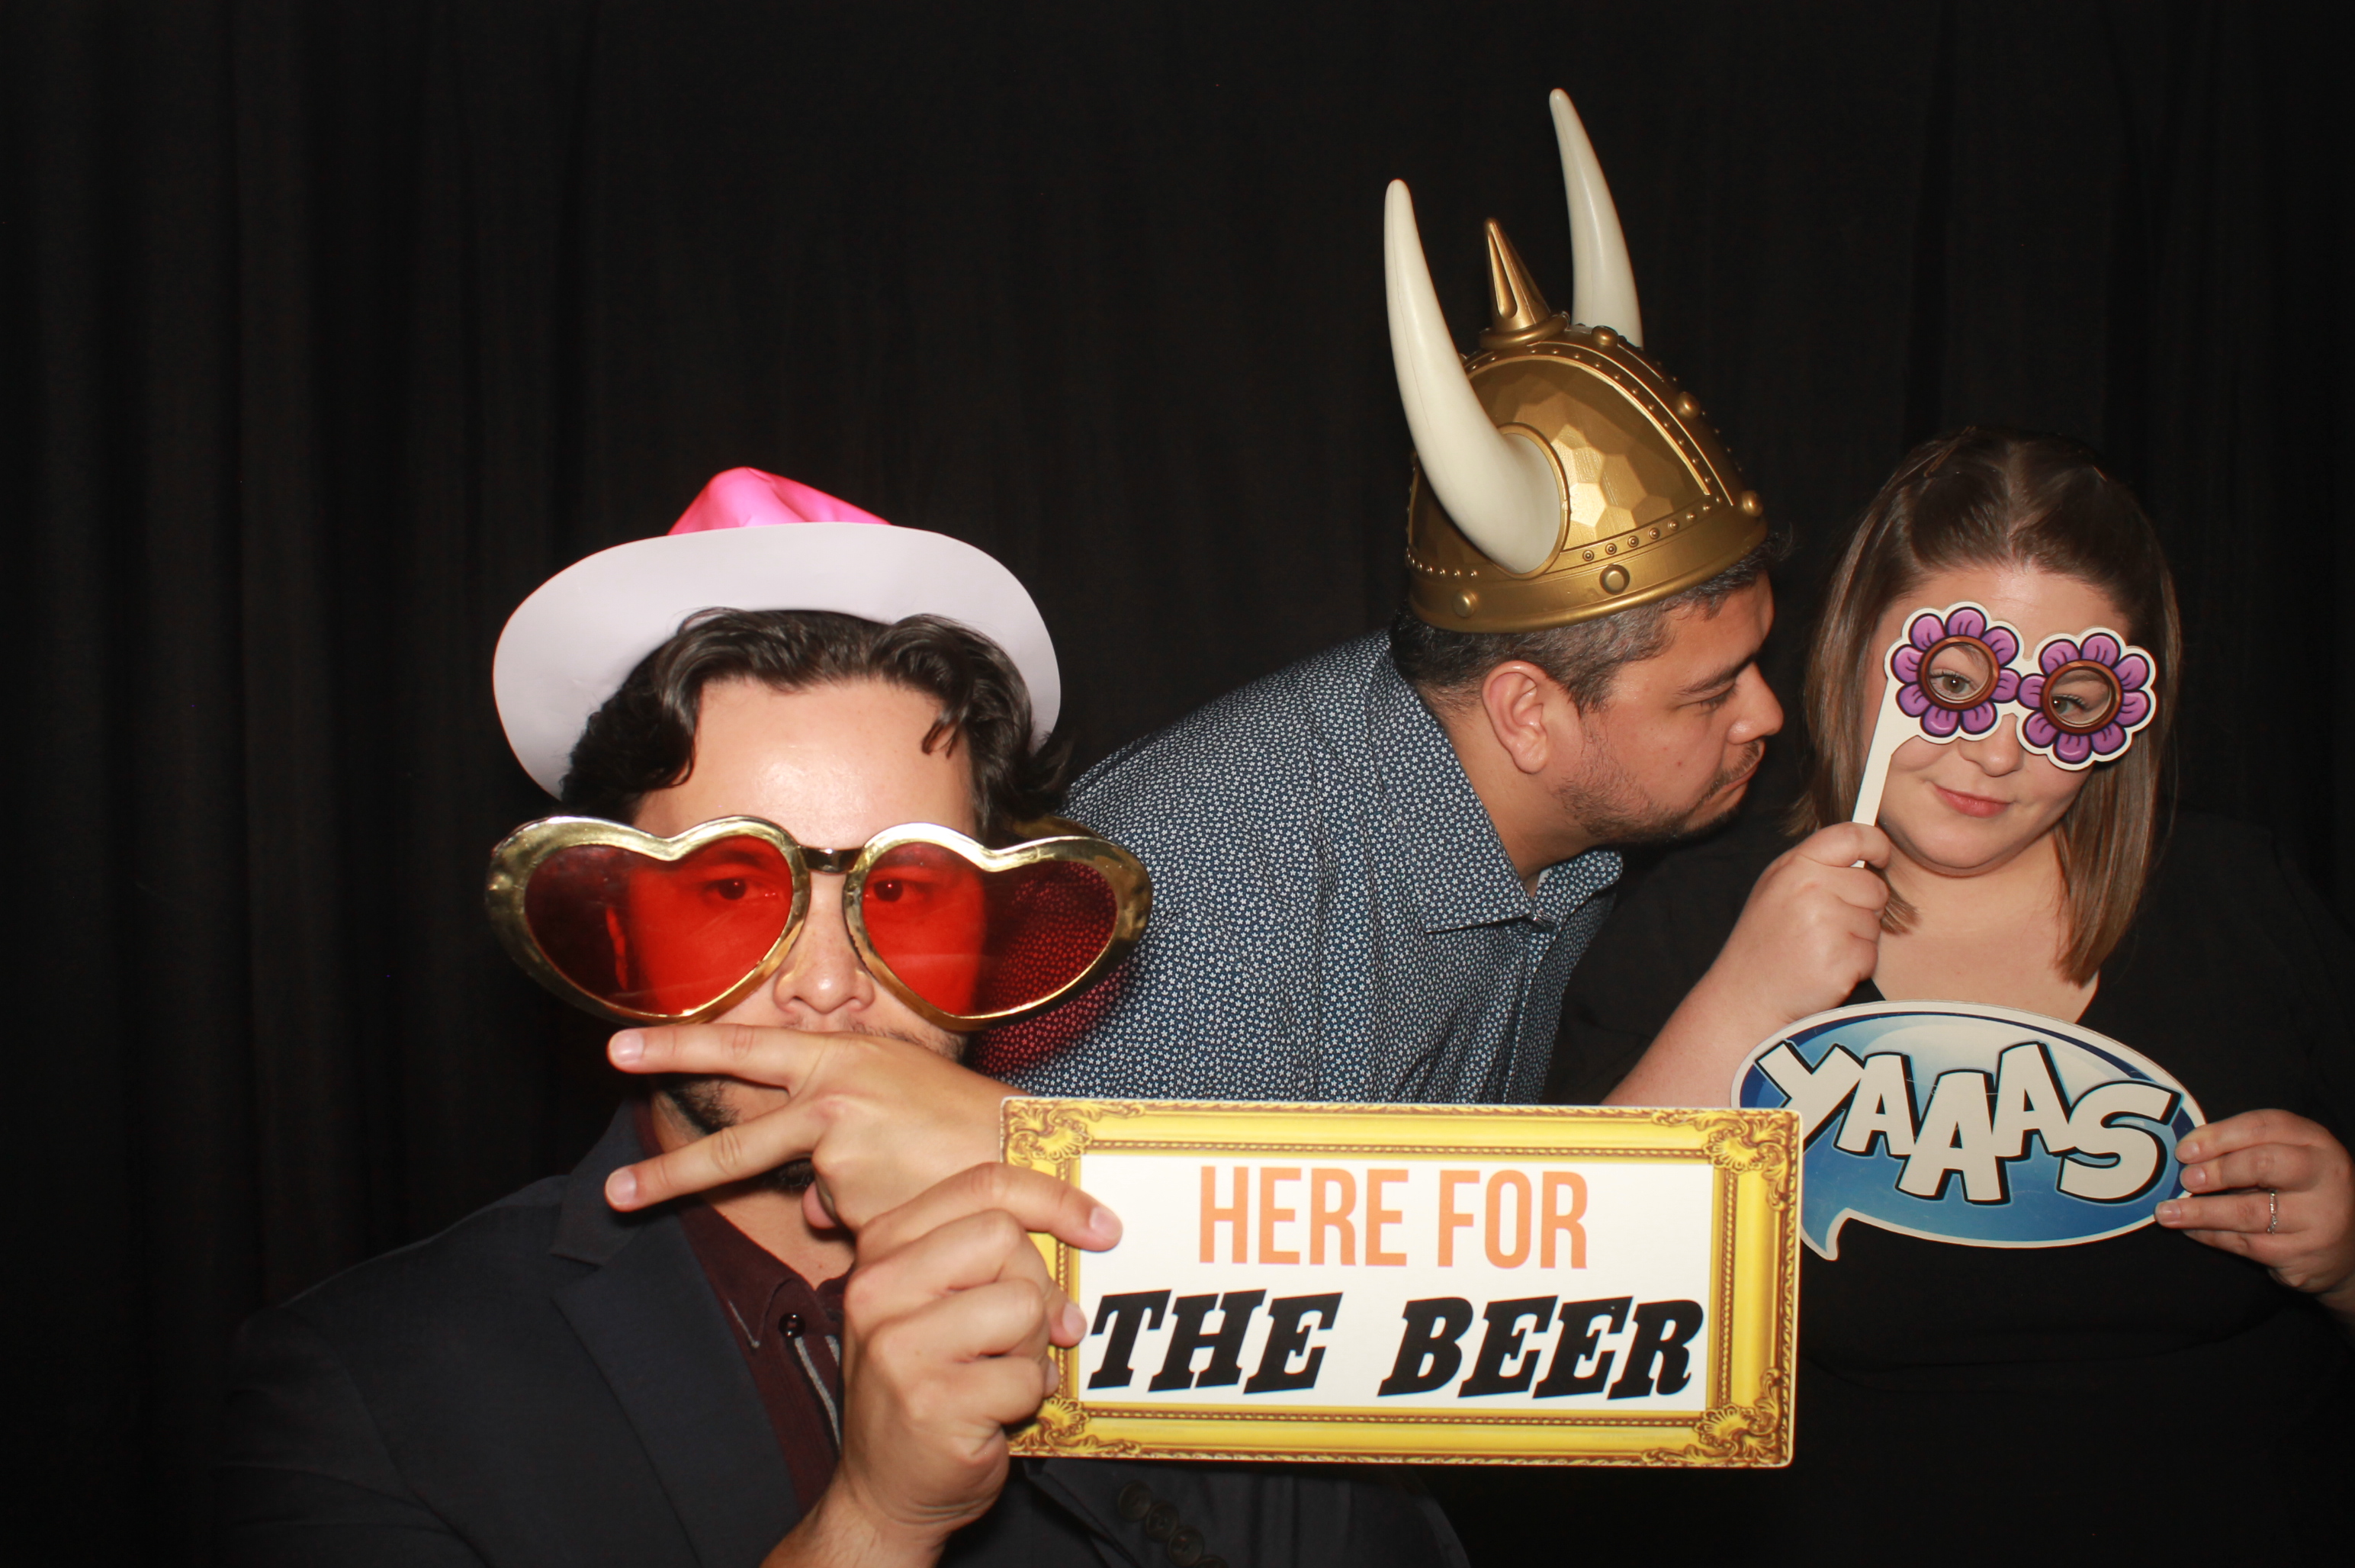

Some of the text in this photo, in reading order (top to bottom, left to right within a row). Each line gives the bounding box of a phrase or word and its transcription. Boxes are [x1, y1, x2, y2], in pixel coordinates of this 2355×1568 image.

[1755, 1039, 2183, 1204] YAAAS
[1199, 1166, 1589, 1269] HERE FOR
[1088, 1289, 1704, 1399] THE BEER
